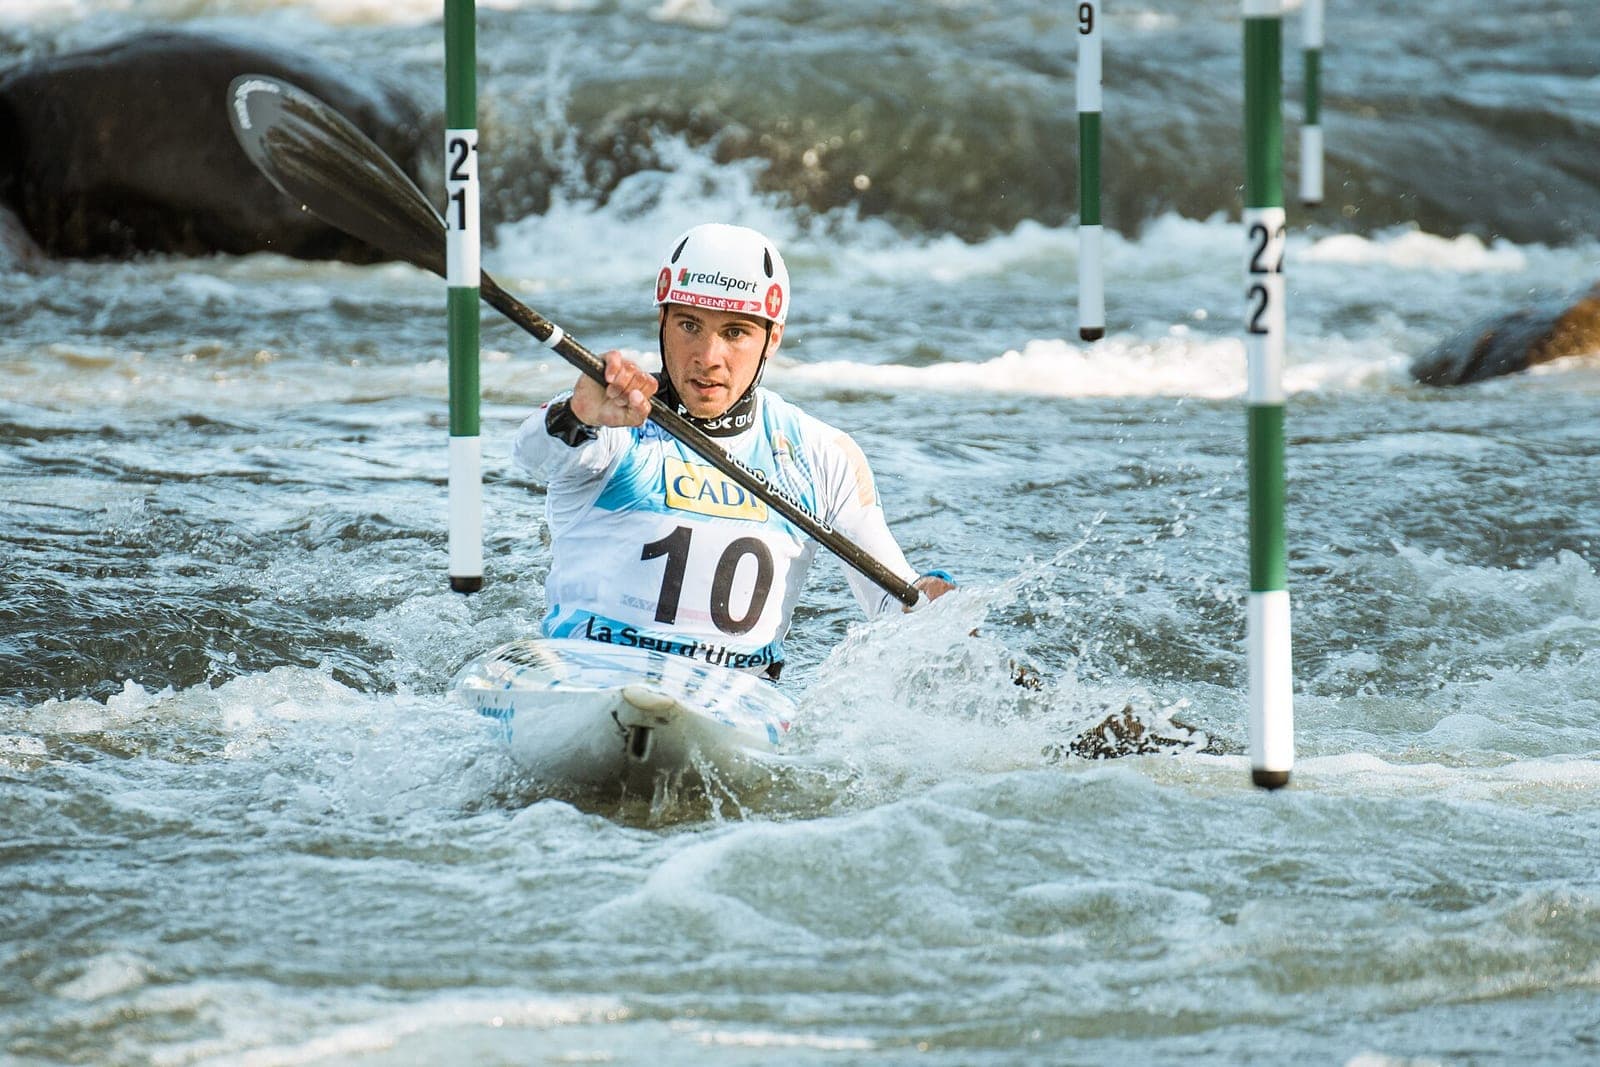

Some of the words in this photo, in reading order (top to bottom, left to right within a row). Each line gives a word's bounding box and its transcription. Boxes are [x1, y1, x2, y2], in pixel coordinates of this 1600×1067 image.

[1079, 2, 1094, 35] 9
[690, 271, 758, 293] realsport
[672, 291, 696, 303] TEAM
[698, 295, 739, 309] GENÈVE
[641, 526, 774, 636] 10
[586, 616, 612, 643] La
[620, 627, 672, 652] Seu
[680, 641, 774, 668] d'Urgell
